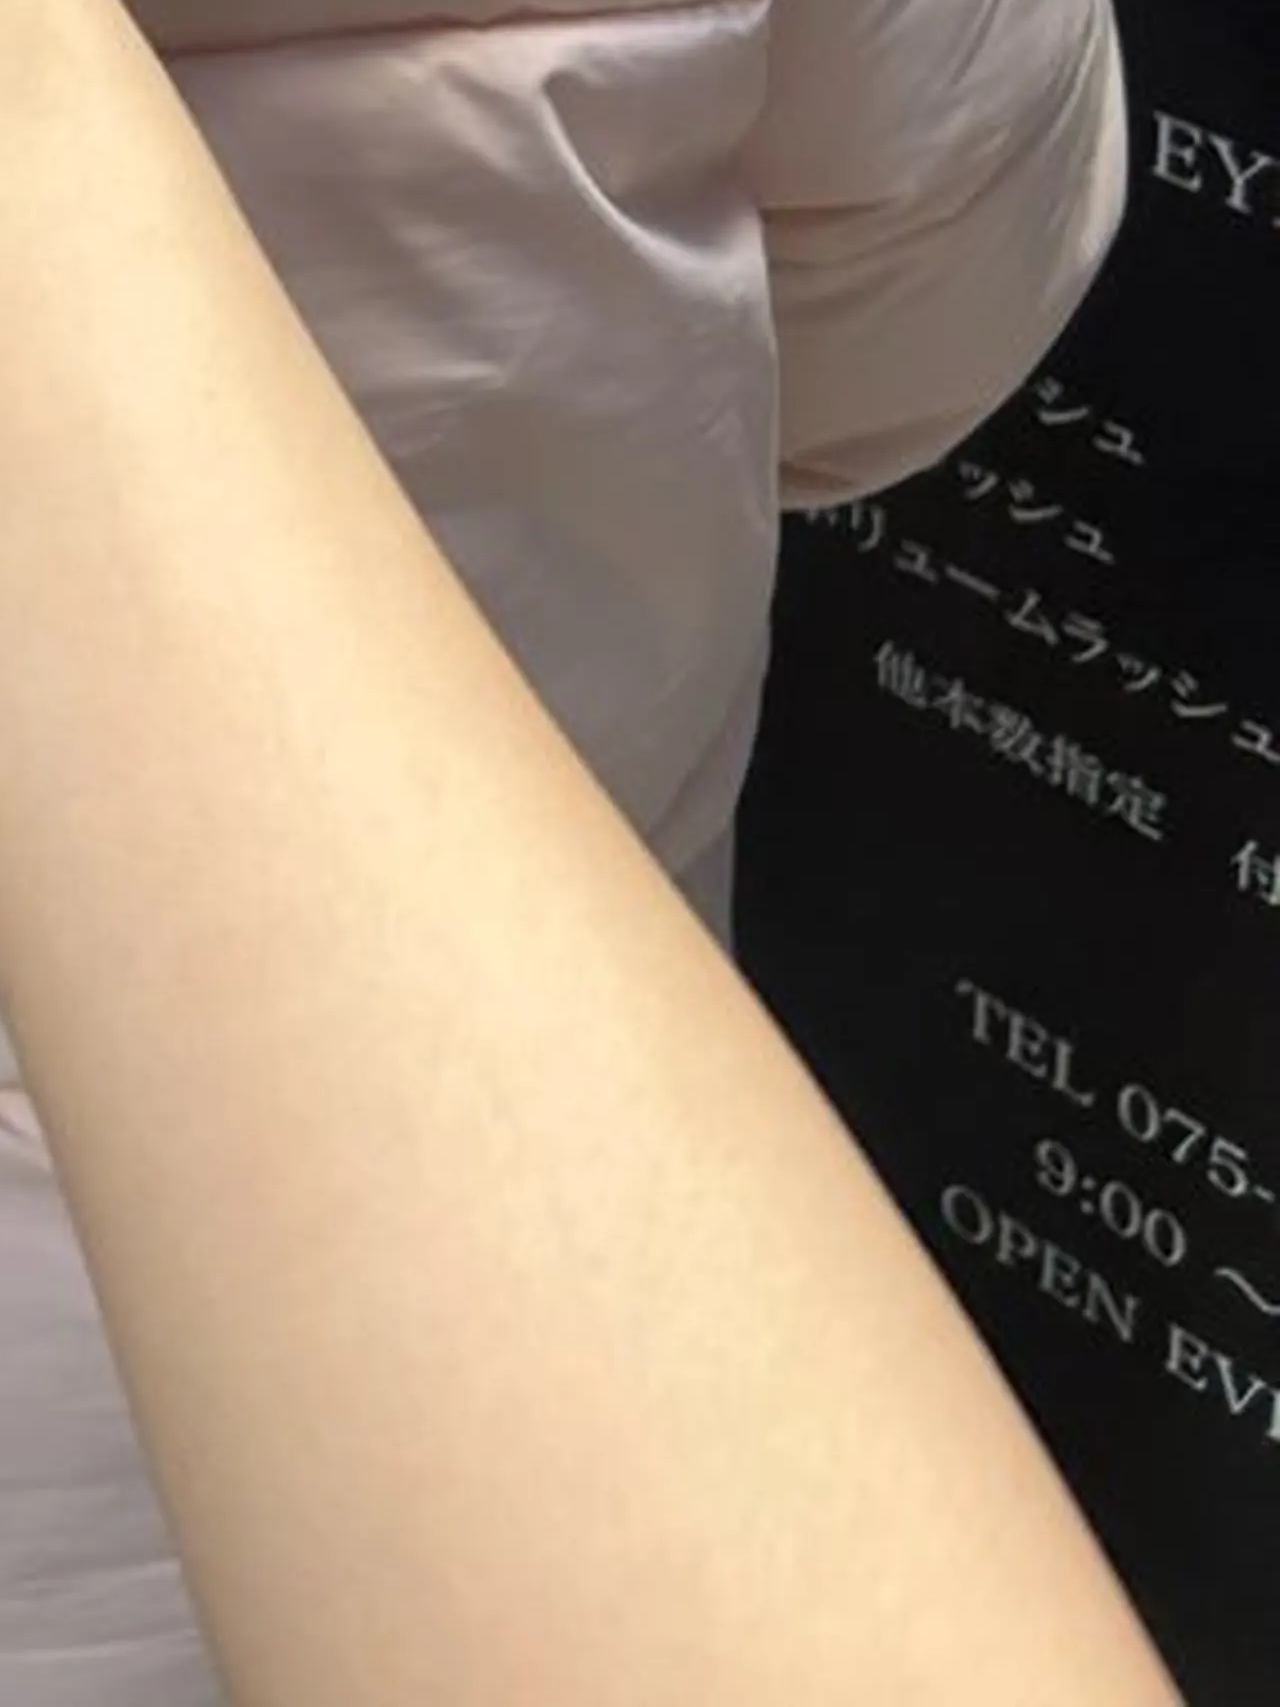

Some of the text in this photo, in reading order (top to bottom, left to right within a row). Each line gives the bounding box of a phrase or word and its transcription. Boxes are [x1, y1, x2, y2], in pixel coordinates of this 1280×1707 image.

[1151, 110, 1280, 228] EY
[955, 979, 1096, 1108] TEL
[940, 1185, 1141, 1344] OPEN
[1035, 1139, 1188, 1268] 9:00
